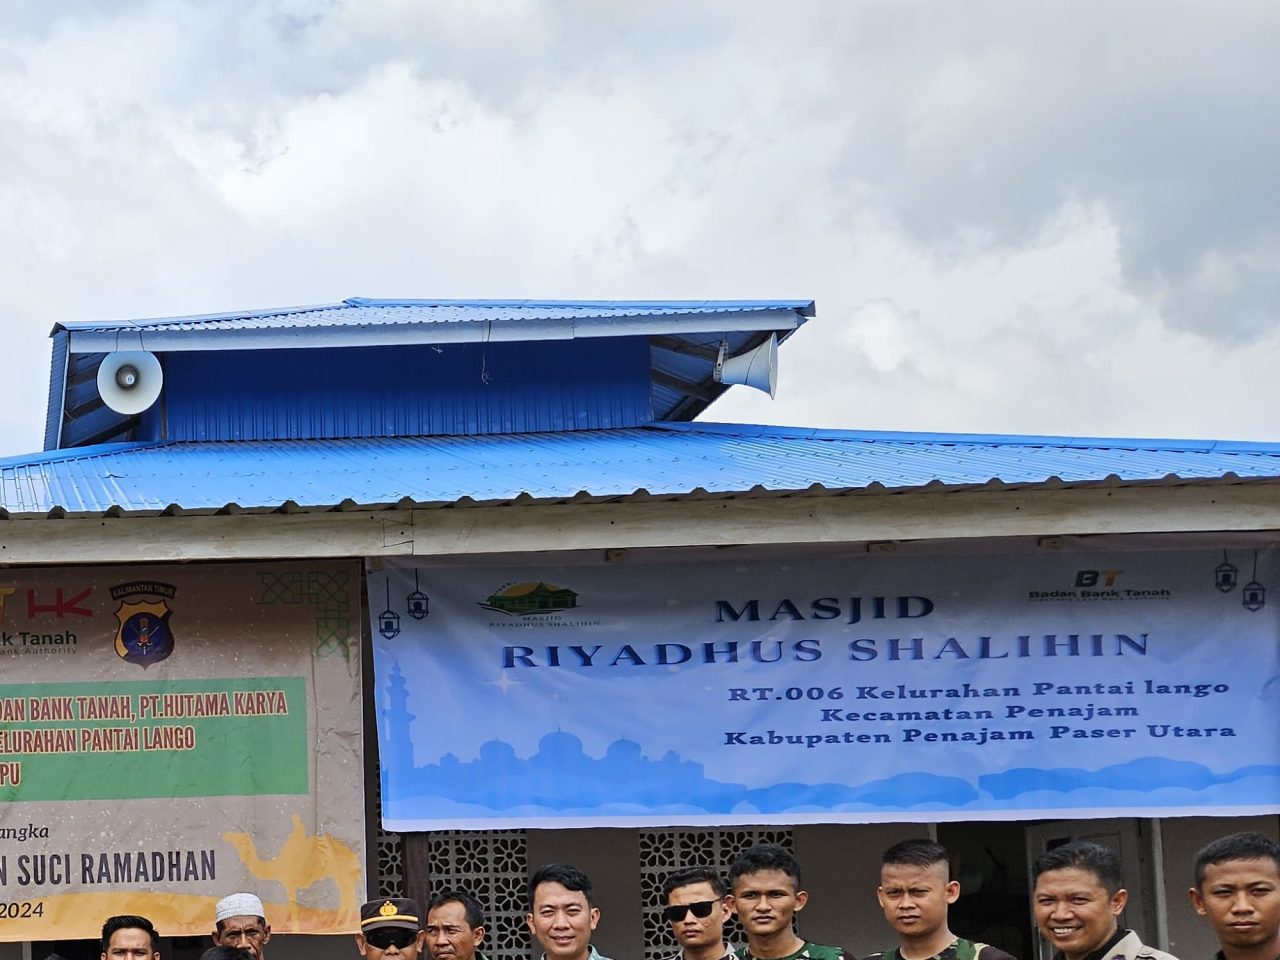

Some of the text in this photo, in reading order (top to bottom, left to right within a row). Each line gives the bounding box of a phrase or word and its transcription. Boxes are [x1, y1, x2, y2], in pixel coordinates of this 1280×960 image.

[1029, 589, 1170, 599] Badan Bank Tanah
[714, 596, 935, 624] MASJID
[19, 631, 77, 646] Tanah
[24, 647, 78, 656] Authority
[503, 633, 1149, 668] RIYADHUS SHALIHIN
[728, 679, 1230, 701] RT.006 Kelurahan Pantai lango
[29, 695, 74, 722] BANK
[77, 694, 136, 723] TANAH,
[139, 692, 231, 719] PT.HUTAMA
[233, 690, 288, 715] KARYA
[821, 704, 1140, 722] Kecamatan Penajam
[80, 727, 140, 753] PANTAI
[142, 725, 196, 751] LANGO
[724, 723, 1237, 750] Kabupaten Penajam Paser Utara
[17, 852, 72, 887] SUCI
[81, 849, 216, 884] RAMADHAN
